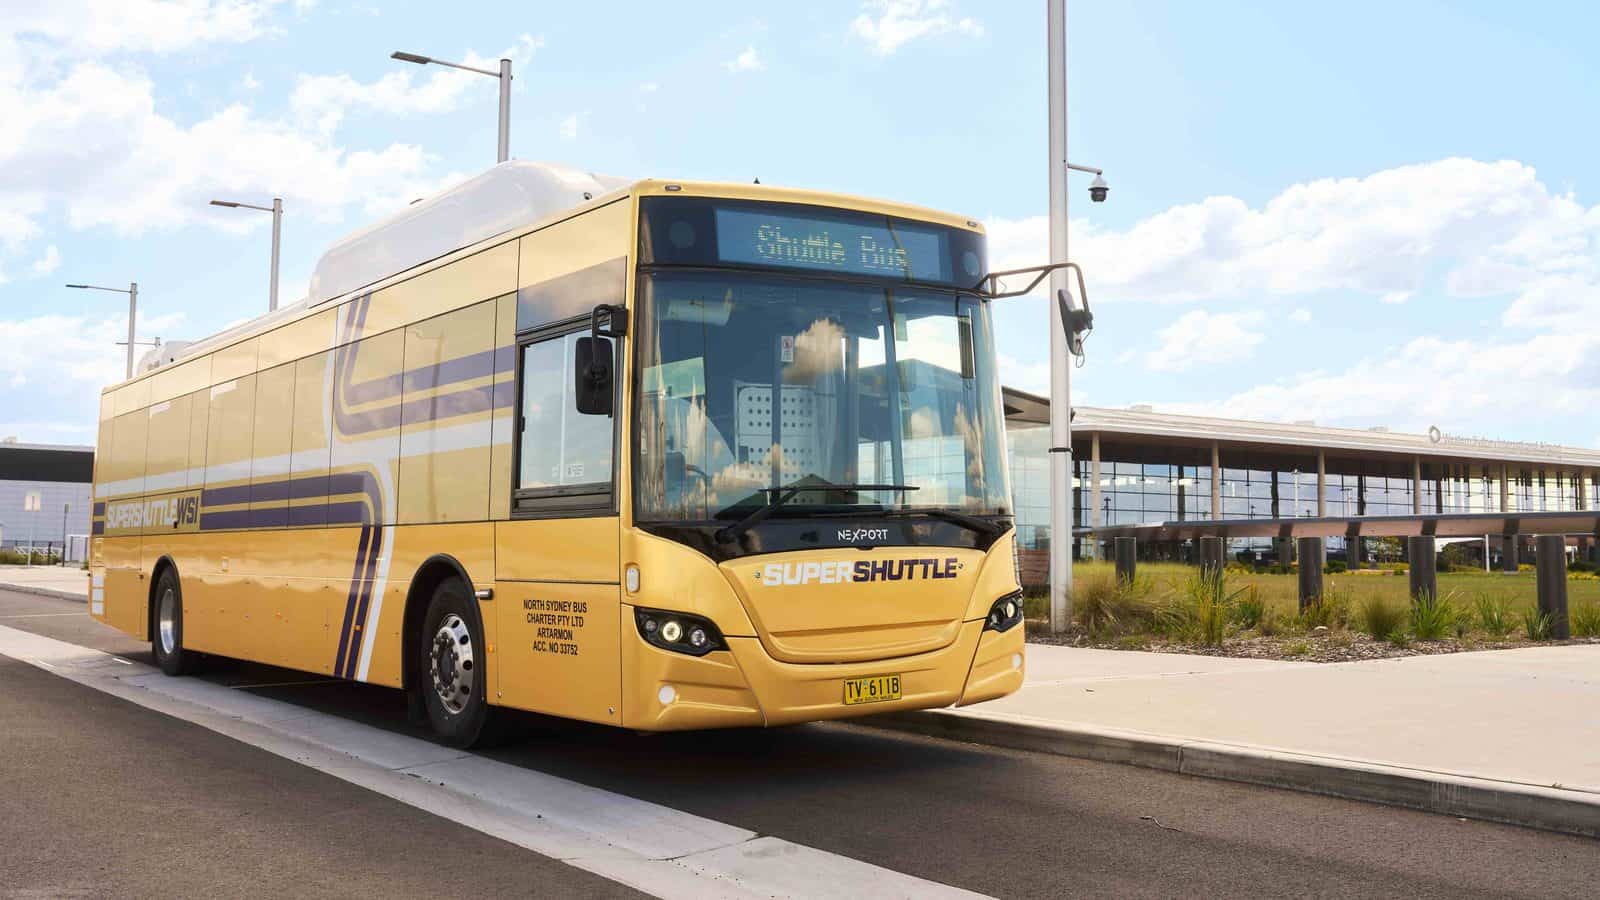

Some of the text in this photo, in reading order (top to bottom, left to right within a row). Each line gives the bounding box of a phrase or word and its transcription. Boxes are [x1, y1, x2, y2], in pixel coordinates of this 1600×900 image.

[757, 224, 911, 271] Shuttle Bus
[838, 529, 888, 543] NEXPORT
[763, 557, 958, 586] SUPERSHUTTLE
[523, 599, 587, 613] NORTH SYDNEY BUS
[527, 613, 584, 627] CHARTER PTY LTD
[537, 627, 573, 640] ARTARMON
[549, 642, 559, 653] NO
[560, 643, 578, 655] 33752
[847, 681, 862, 698] TV
[869, 677, 899, 696] 611B
